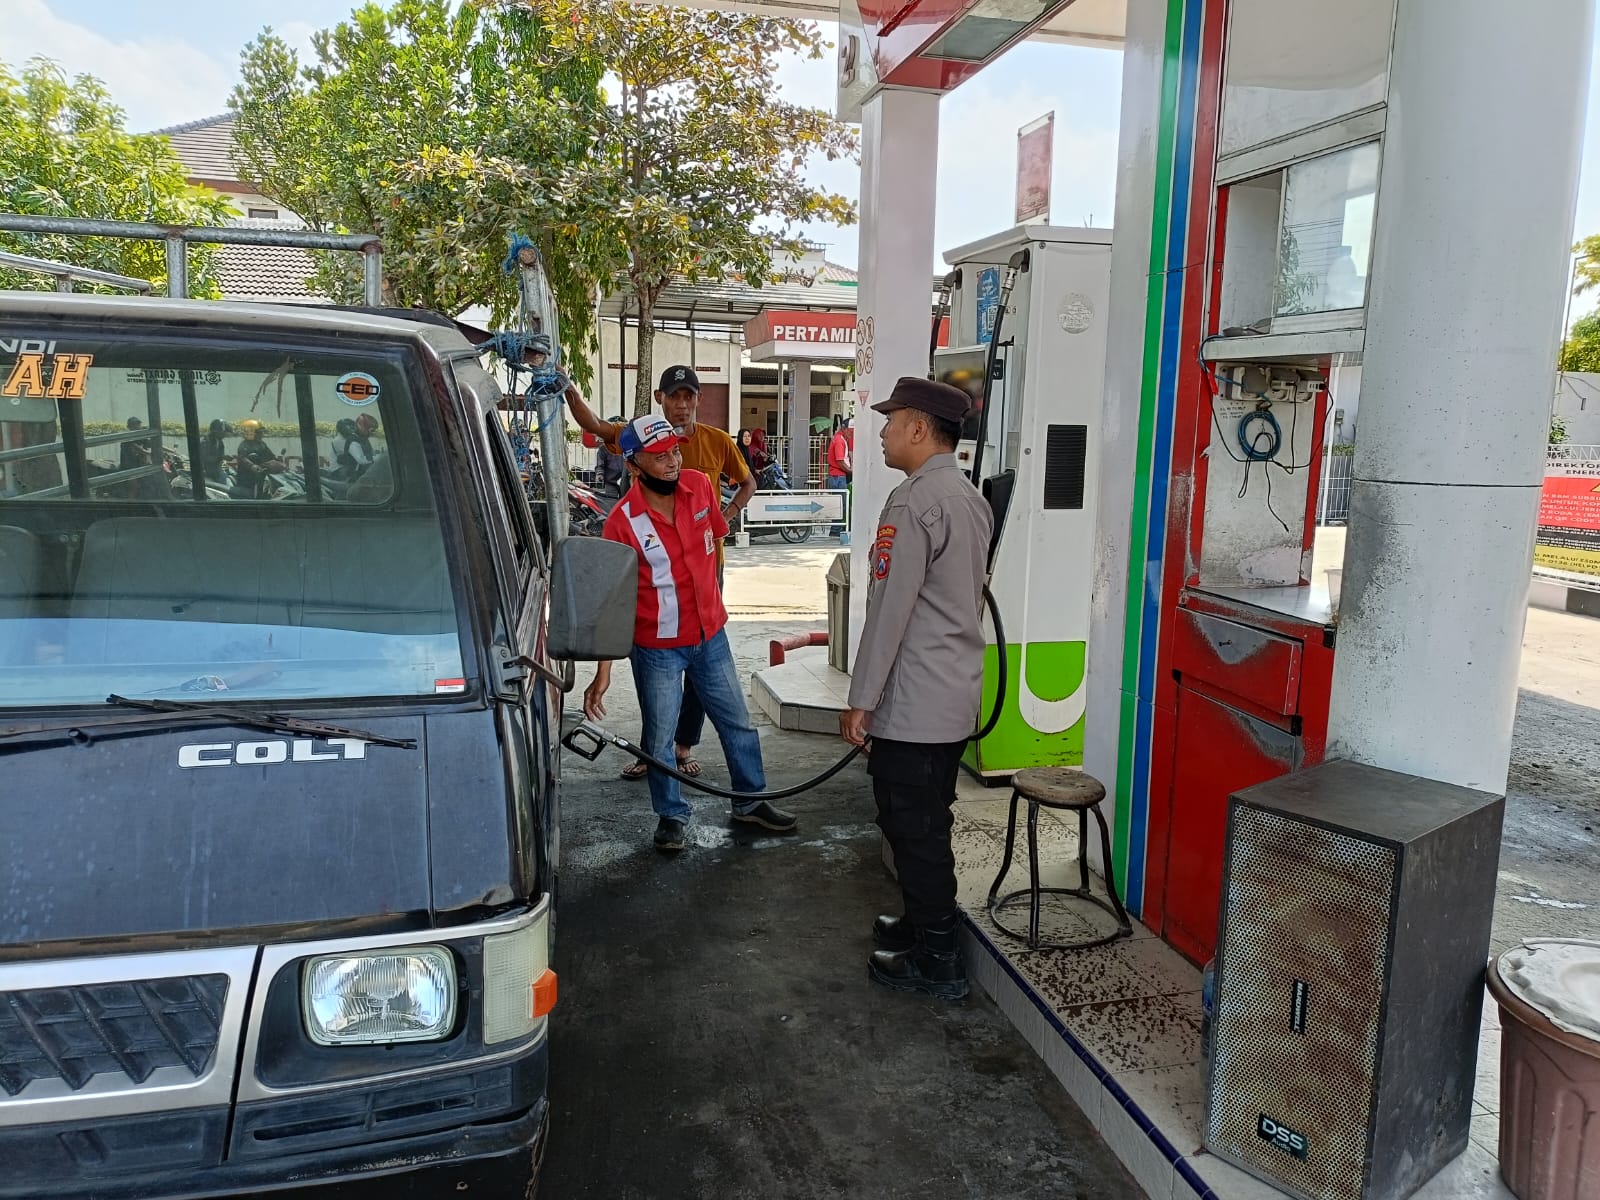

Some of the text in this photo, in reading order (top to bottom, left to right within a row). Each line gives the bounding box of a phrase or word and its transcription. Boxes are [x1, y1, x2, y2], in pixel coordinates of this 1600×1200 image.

[1, 353, 94, 399] AH
[1570, 562, 1600, 570] (HELPD
[178, 738, 377, 768] COLT
[1262, 1117, 1304, 1150] DSS
